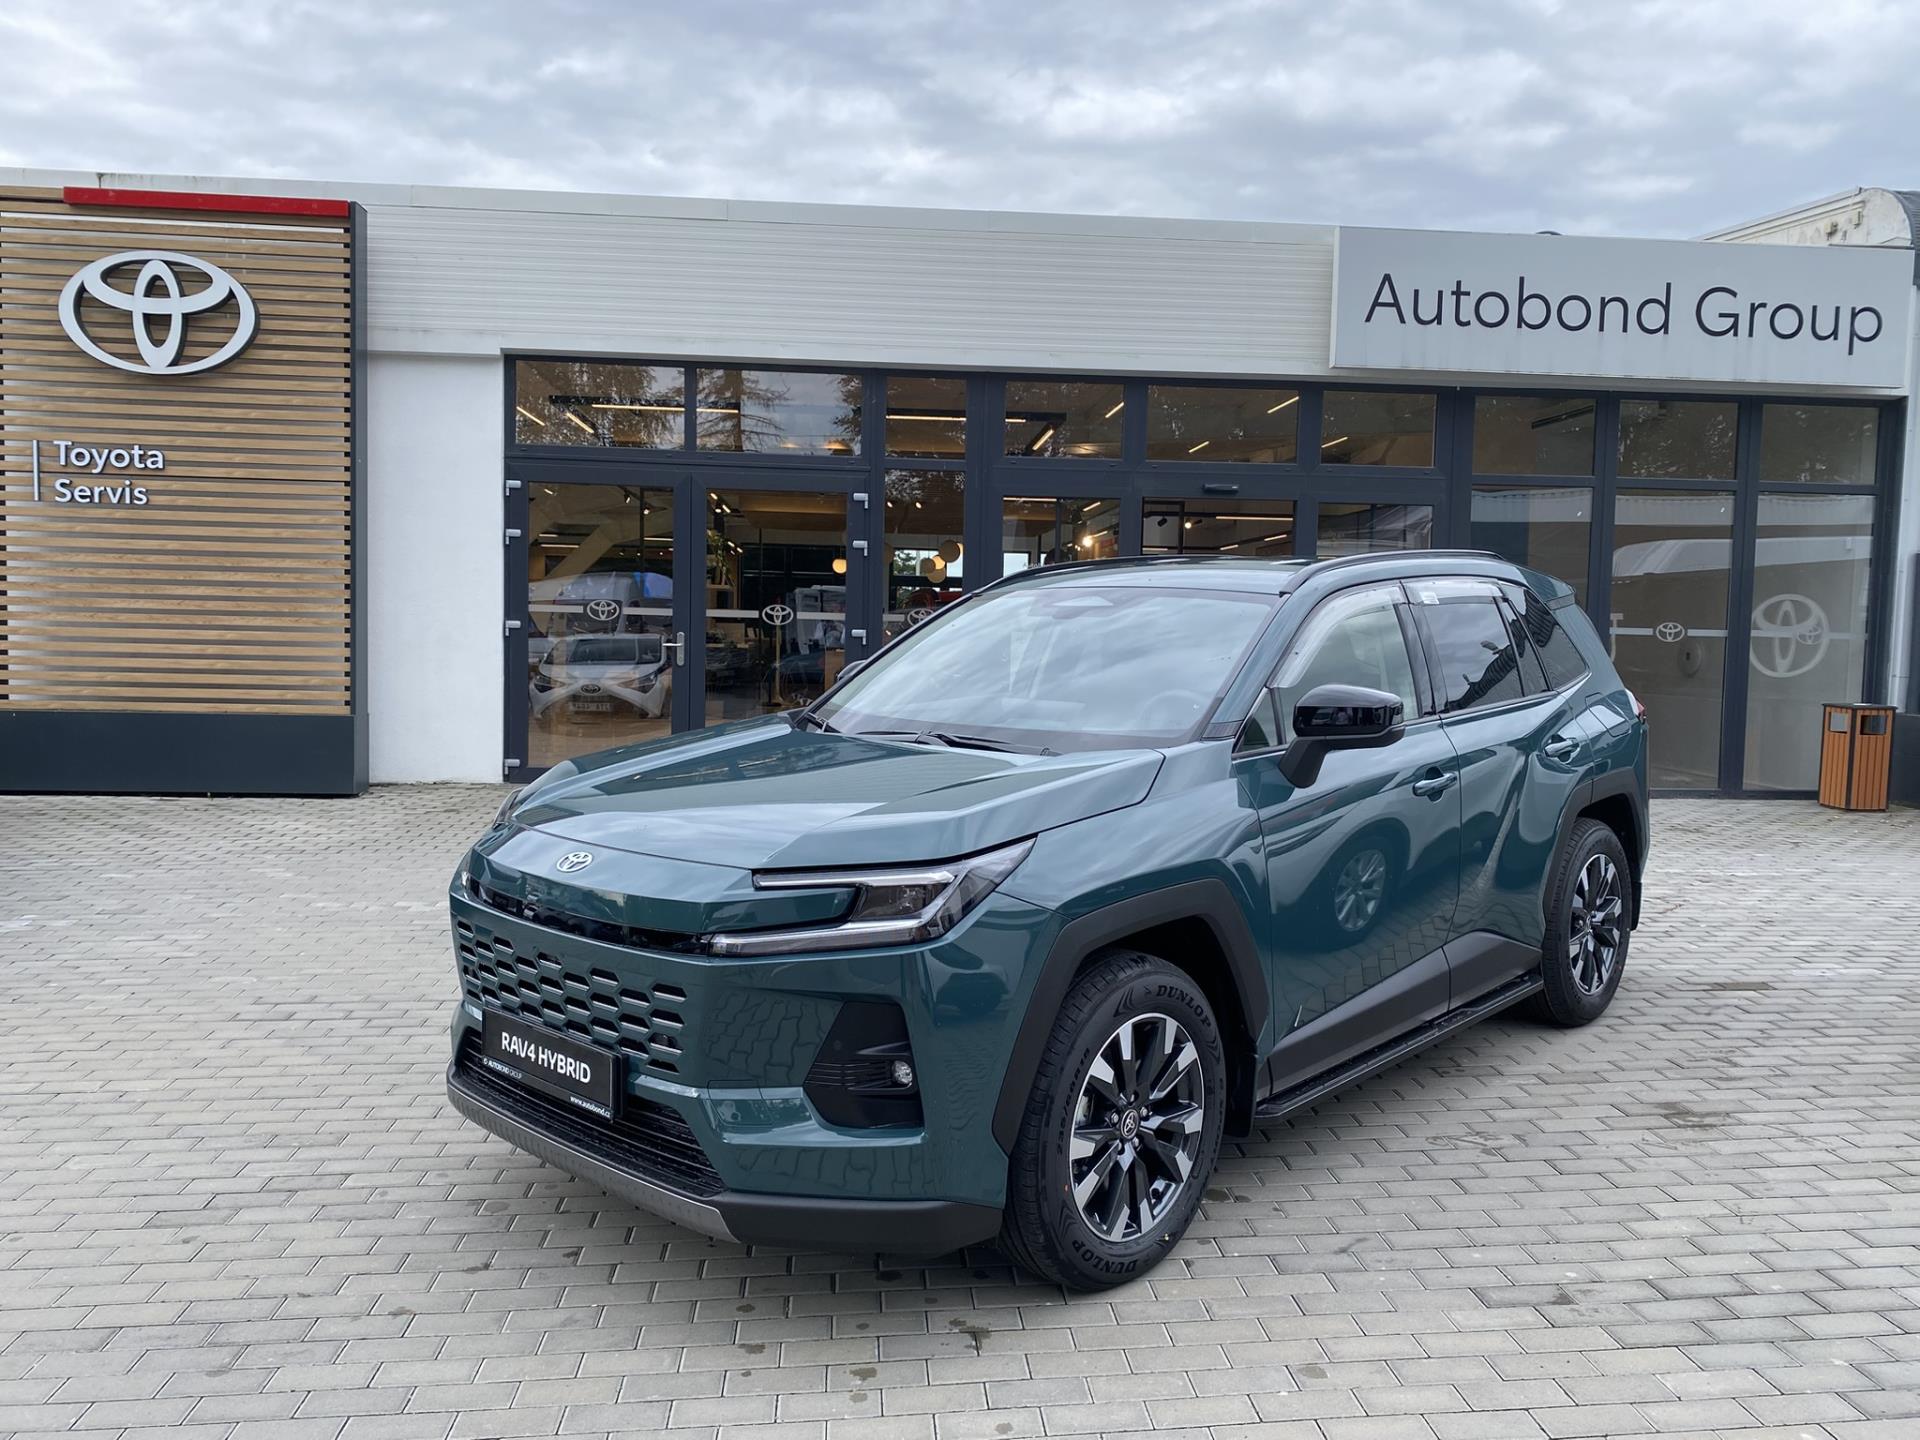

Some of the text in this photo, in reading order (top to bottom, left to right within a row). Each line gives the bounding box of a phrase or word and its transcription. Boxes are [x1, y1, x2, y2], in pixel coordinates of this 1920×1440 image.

[1364, 273, 1883, 356] Autobond Group
[53, 440, 165, 474] Toyota
[54, 479, 148, 505] Servis
[1156, 985, 1211, 1027] DUNLOP
[501, 1031, 591, 1084] RAV4 HYBRID
[1072, 1240, 1138, 1274] DUNLOP
